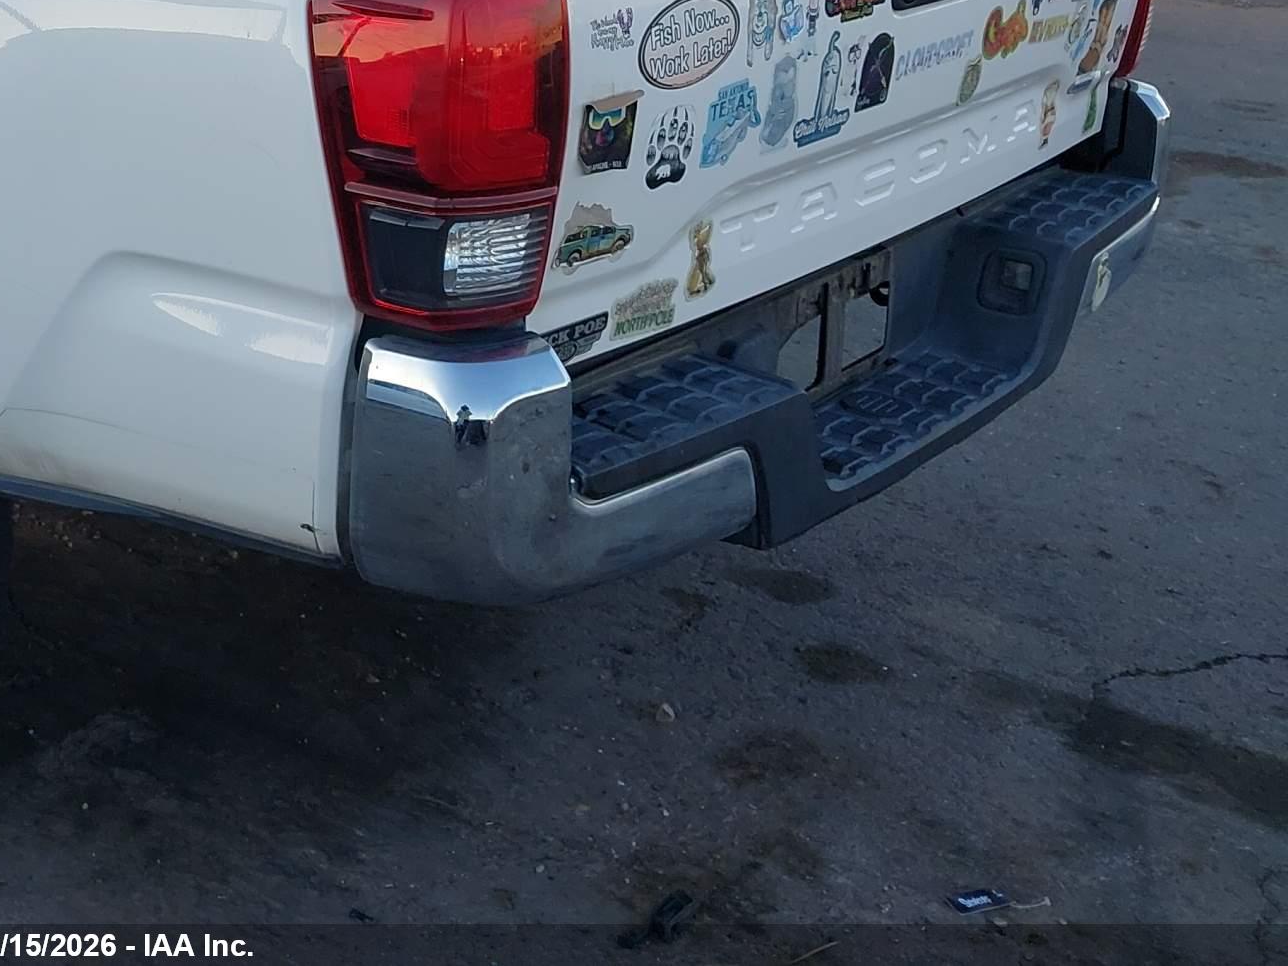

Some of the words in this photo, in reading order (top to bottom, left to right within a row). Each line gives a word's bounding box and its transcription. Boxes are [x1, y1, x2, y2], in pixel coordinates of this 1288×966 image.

[650, 14, 681, 51] Fish
[684, 7, 730, 37] Now...
[649, 45, 689, 79] Work
[693, 28, 733, 68] Later!
[711, 89, 754, 122] TEXAS
[718, 98, 1038, 253] TACOMA
